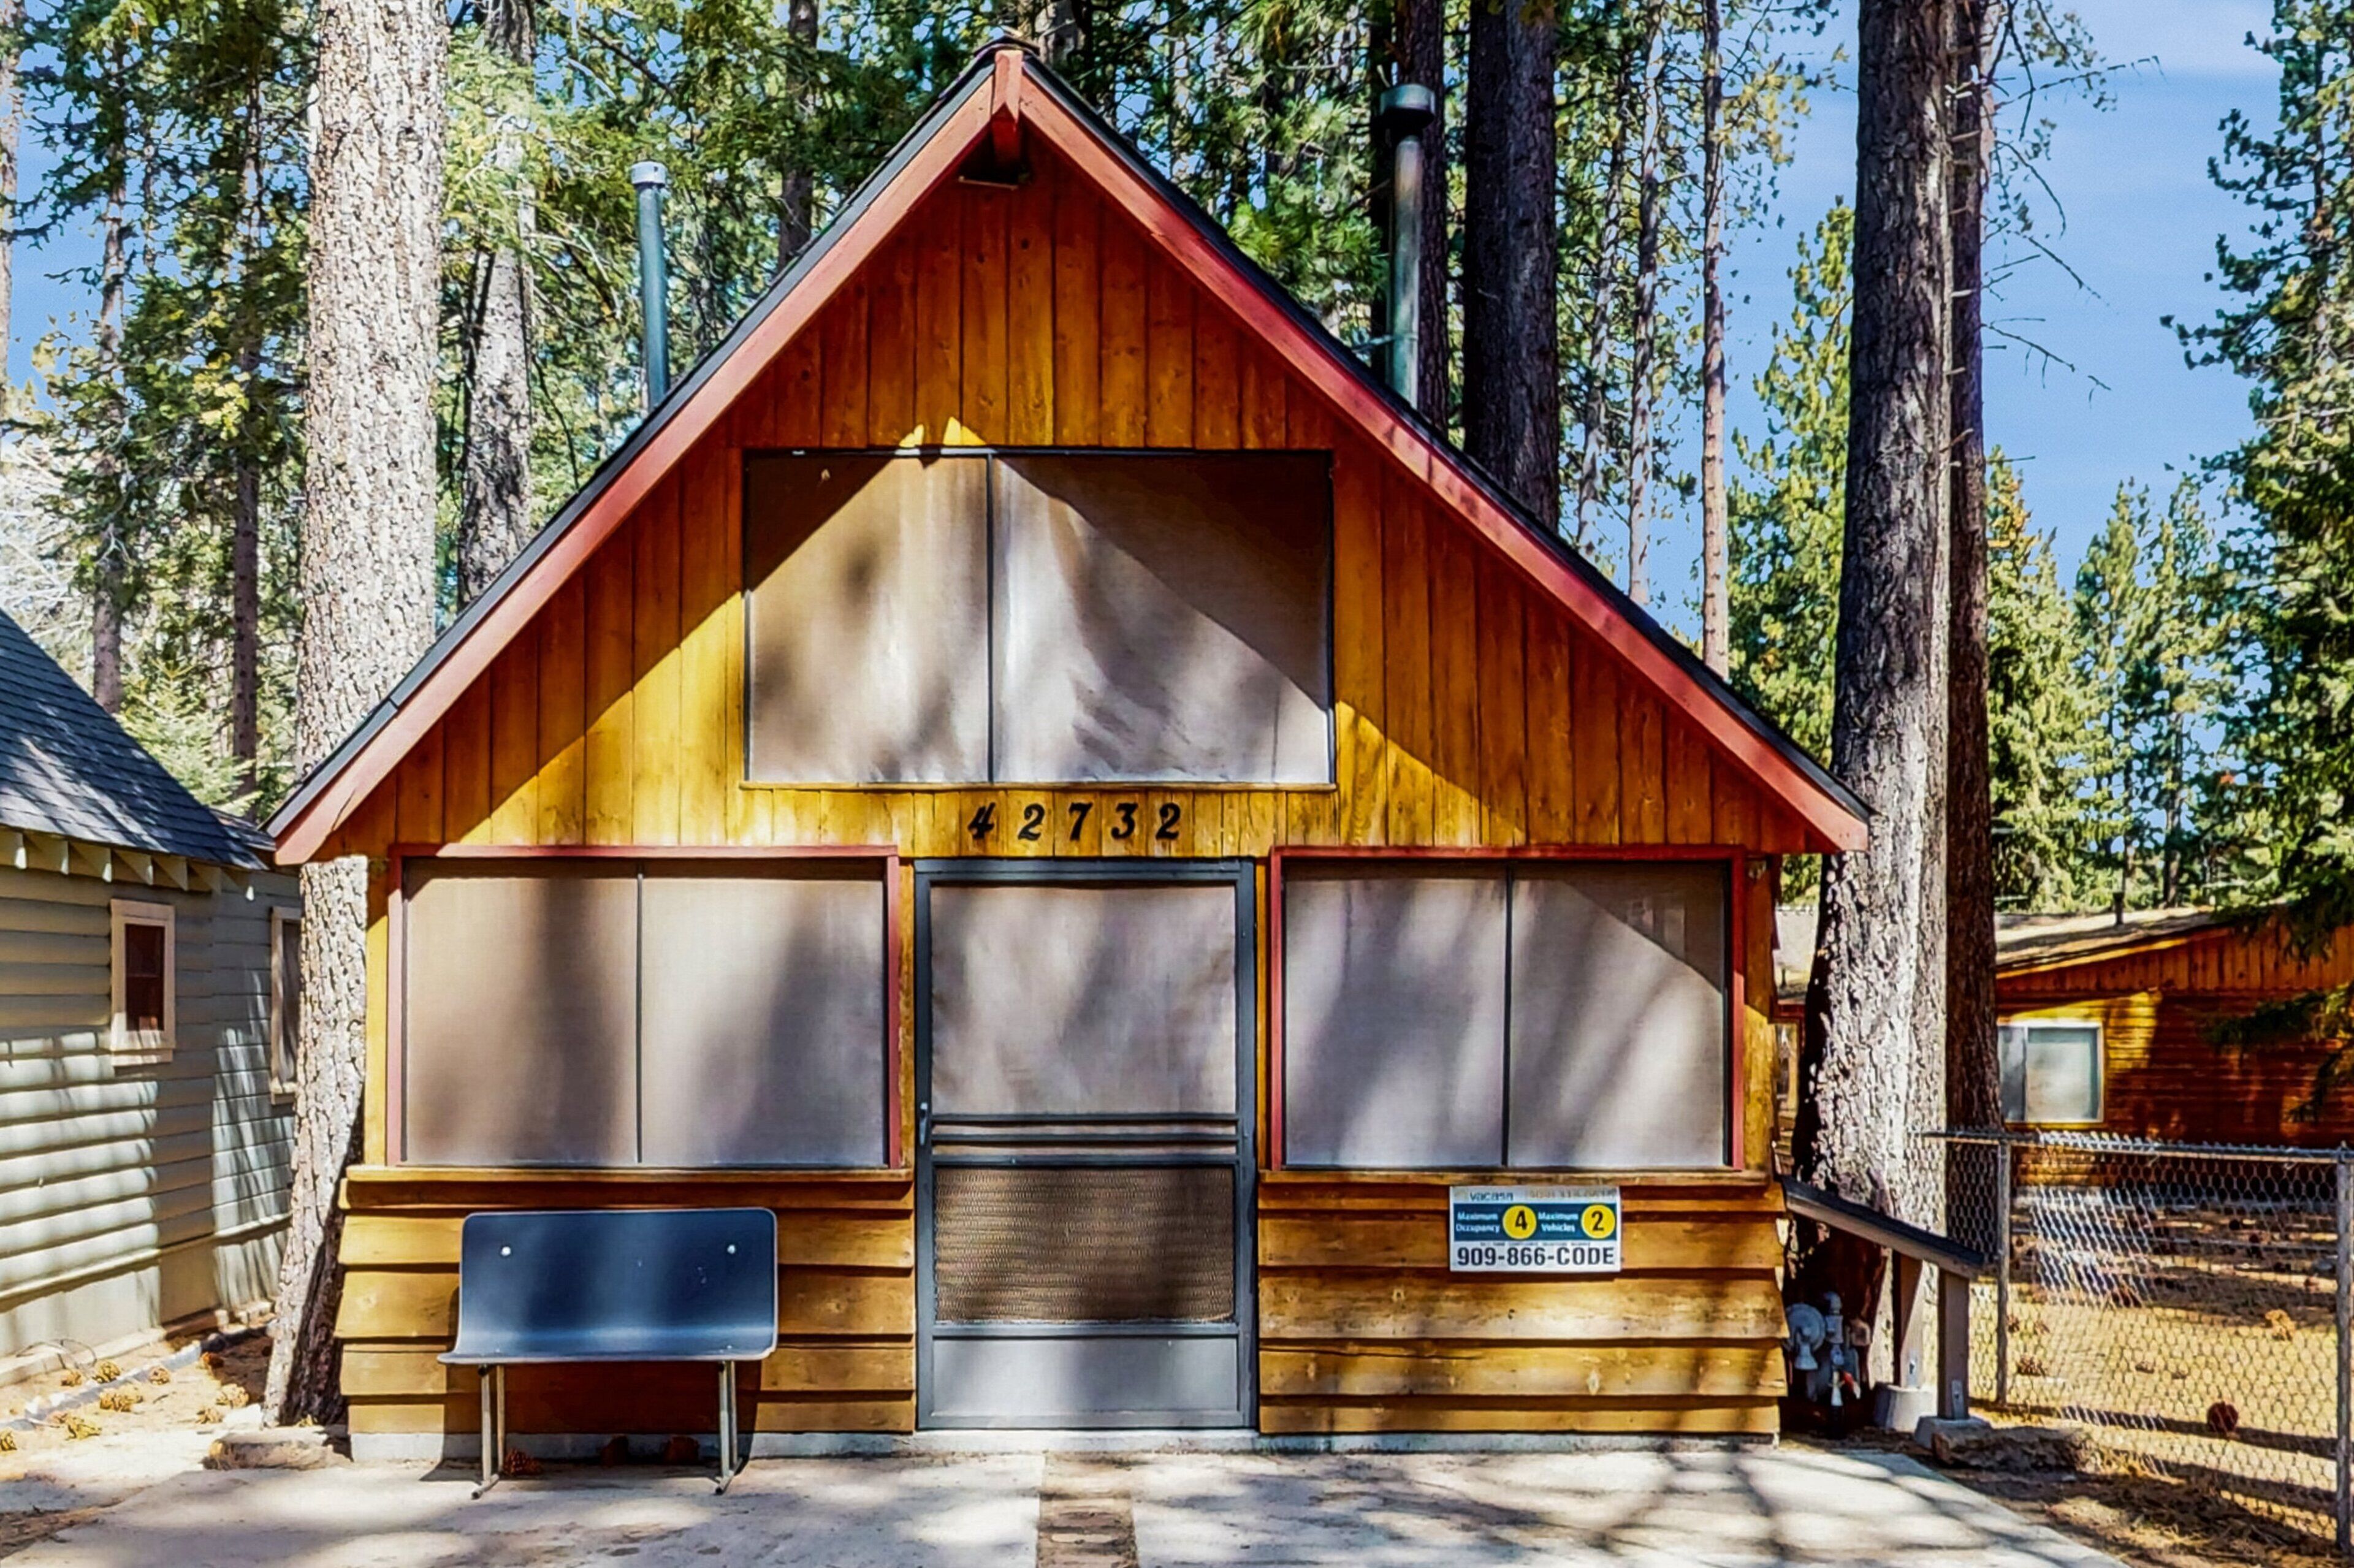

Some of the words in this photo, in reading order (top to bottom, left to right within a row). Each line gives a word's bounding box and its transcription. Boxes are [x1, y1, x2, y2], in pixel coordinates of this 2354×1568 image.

[1457, 1211, 1498, 1220] Maximum
[1538, 1211, 1579, 1220] Maximum
[1515, 1210, 1528, 1231] 4
[1591, 1210, 1604, 1231] 2
[1455, 1224, 1500, 1233] Occupancy
[1541, 1223, 1575, 1232] Vehicles
[1457, 1247, 1615, 1266] 909-866-CODE
